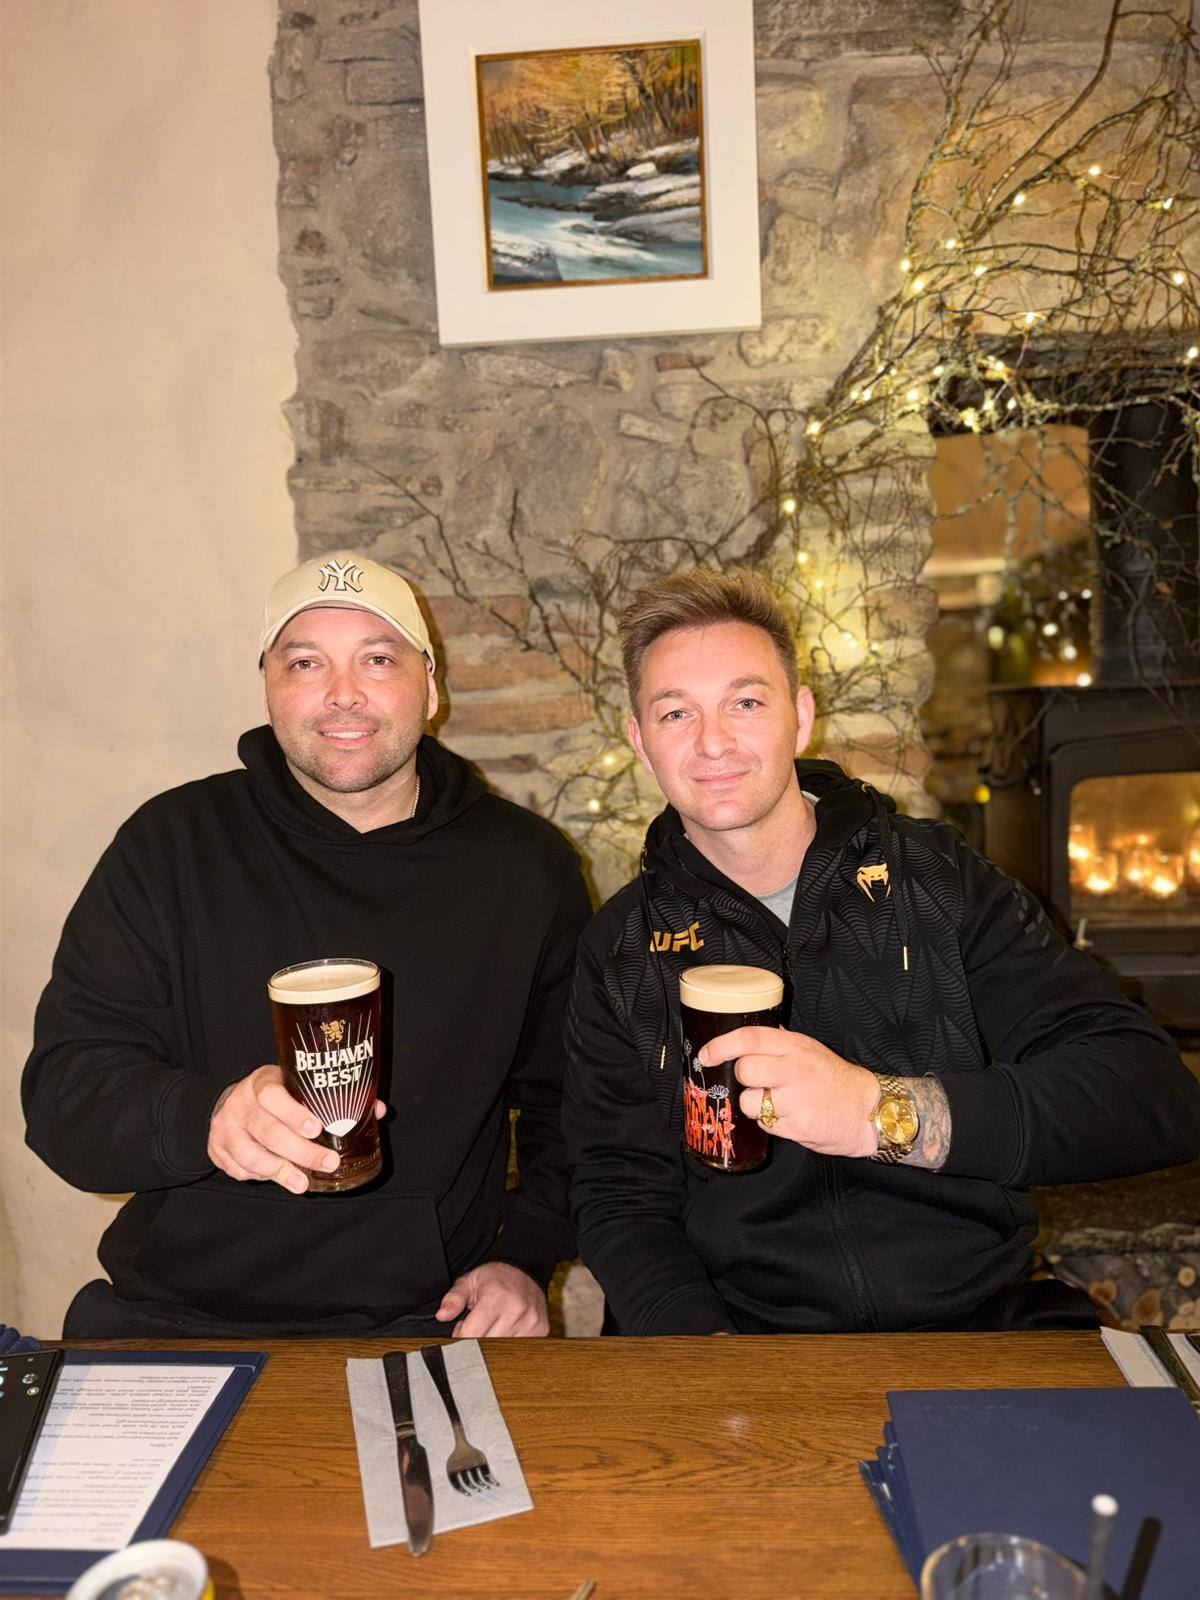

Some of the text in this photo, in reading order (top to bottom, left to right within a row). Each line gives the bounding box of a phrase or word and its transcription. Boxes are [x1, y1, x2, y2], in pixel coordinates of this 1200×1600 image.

[318, 559, 364, 593] NY
[649, 921, 705, 953] UFC
[294, 1035, 374, 1072] BELHAVEN
[313, 1064, 363, 1089] BEST
